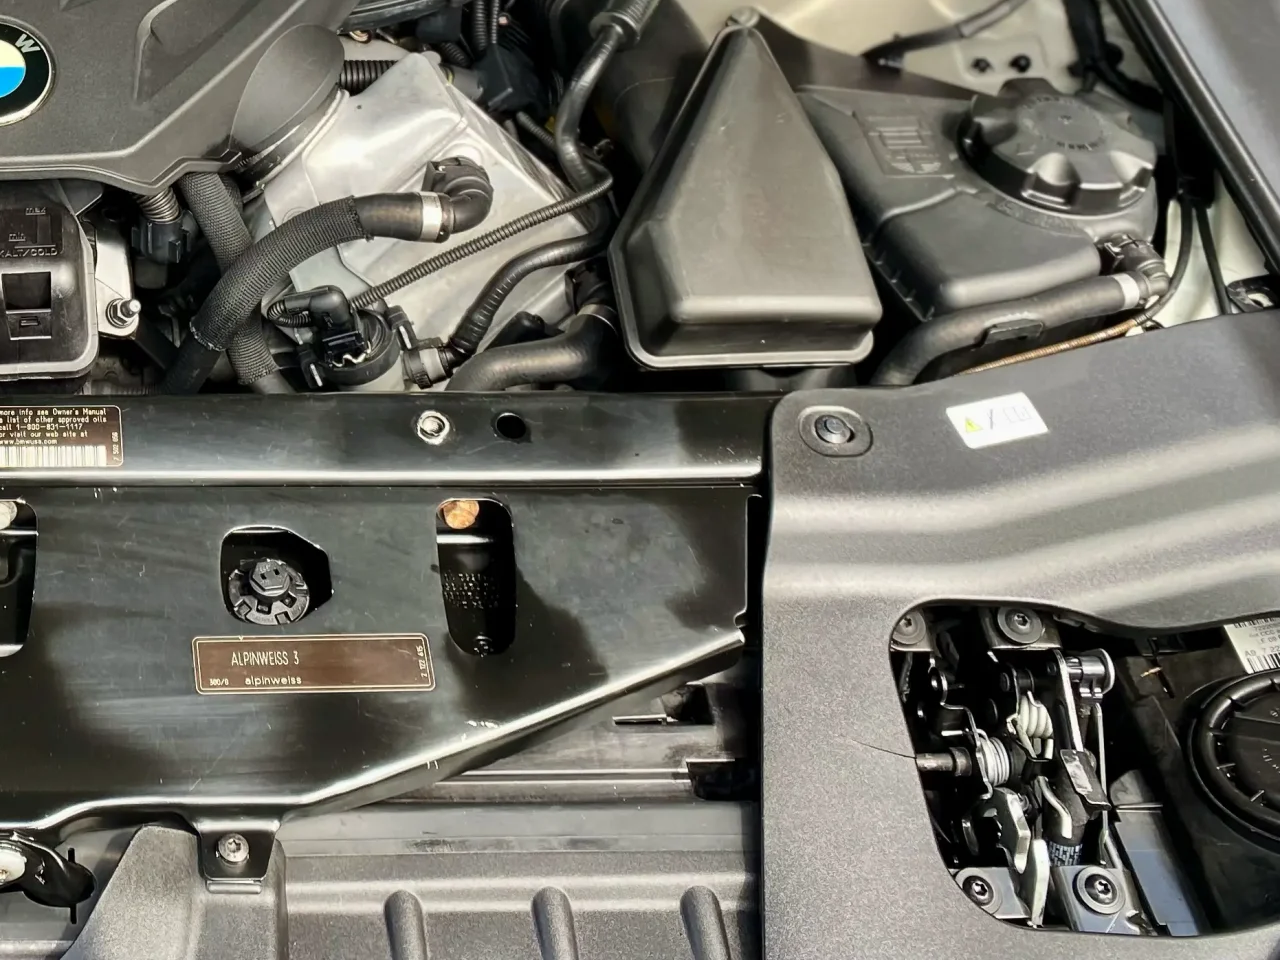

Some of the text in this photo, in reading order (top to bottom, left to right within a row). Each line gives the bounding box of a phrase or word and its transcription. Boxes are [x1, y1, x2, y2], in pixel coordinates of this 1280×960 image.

[18, 408, 34, 416] info
[52, 407, 79, 416] Owner's
[82, 407, 107, 416] Manual
[7, 415, 20, 423] list
[23, 415, 32, 423] of
[35, 415, 54, 423] other
[58, 415, 90, 424] approved
[92, 415, 107, 423] oils
[15, 423, 83, 431] 1-800-831-1117
[9, 430, 27, 438] visit
[45, 430, 59, 438] web
[62, 430, 77, 438] site
[80, 430, 88, 438] at
[231, 650, 300, 667] ALPINWEISS 3
[244, 675, 302, 687] alpinweiss
